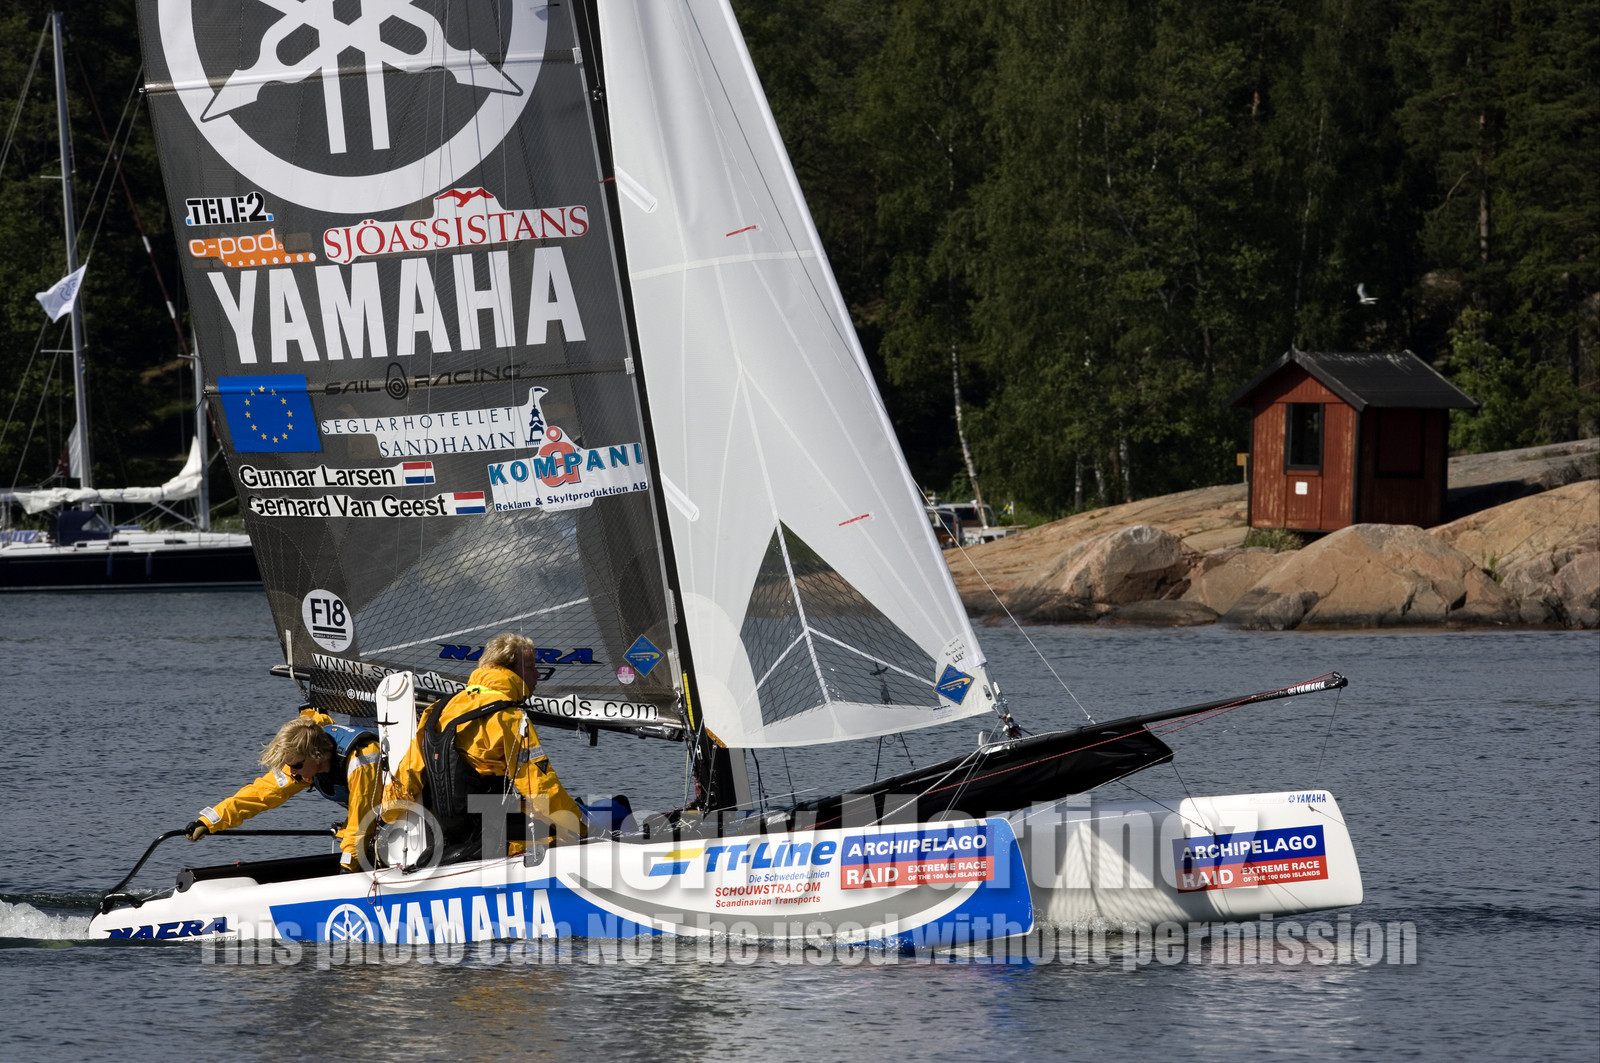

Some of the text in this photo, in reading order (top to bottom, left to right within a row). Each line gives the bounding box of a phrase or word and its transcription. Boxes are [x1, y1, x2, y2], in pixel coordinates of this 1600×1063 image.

[187, 192, 267, 224] TELE2
[323, 206, 589, 264] SJÖASSISTANS
[207, 246, 587, 364] YAMAHA
[325, 365, 521, 396] SAIL RACING
[320, 407, 513, 435] SEGLARHOTELLET
[379, 431, 516, 458] SANDHAMN
[240, 464, 396, 487] Gunnar Larsen
[488, 443, 644, 486] KOMPANI
[247, 494, 448, 517] Gerhard Van Geest
[495, 481, 648, 512] Reklam & Skyltproduktion AB
[310, 598, 346, 627] F18
[356, 690, 376, 702] YAMA
[1297, 680, 1325, 694] YAMAHA
[1297, 793, 1327, 803] YAMAHA
[705, 839, 838, 873] TT-Line
[848, 834, 987, 857] ARCHIPELAGO
[1180, 834, 1318, 861] ARCHIPELAGO
[749, 870, 830, 884] Die Schweden-Linien
[846, 866, 899, 886] RAID
[908, 860, 987, 874] EXTREME RACE
[1182, 869, 1234, 888] RAID
[1242, 860, 1320, 875] EXTREME RACE
[1292, 870, 1321, 878] ISLANDS
[715, 882, 821, 897] SCHOUWSTRA.COM
[715, 895, 821, 908] Scandinavian Transports
[374, 888, 558, 945] YAMAHA
